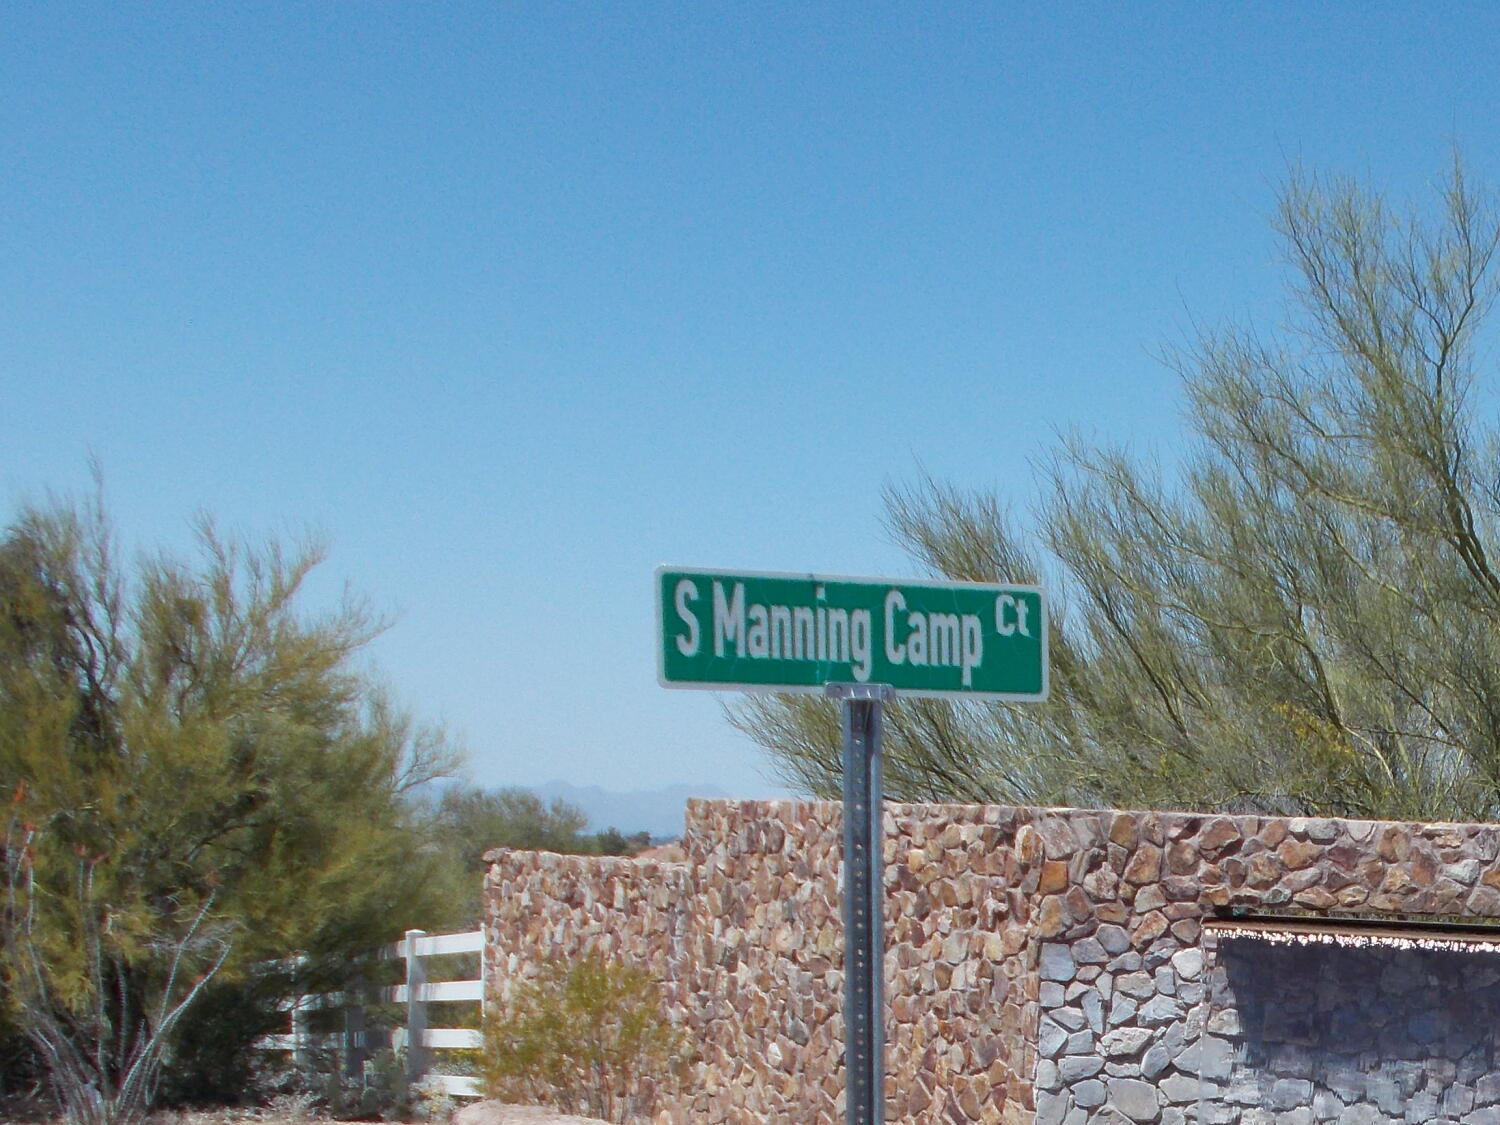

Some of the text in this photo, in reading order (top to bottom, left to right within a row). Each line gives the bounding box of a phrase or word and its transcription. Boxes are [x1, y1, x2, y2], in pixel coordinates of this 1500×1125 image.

[675, 579, 1030, 687] S Manning Camp Ct
